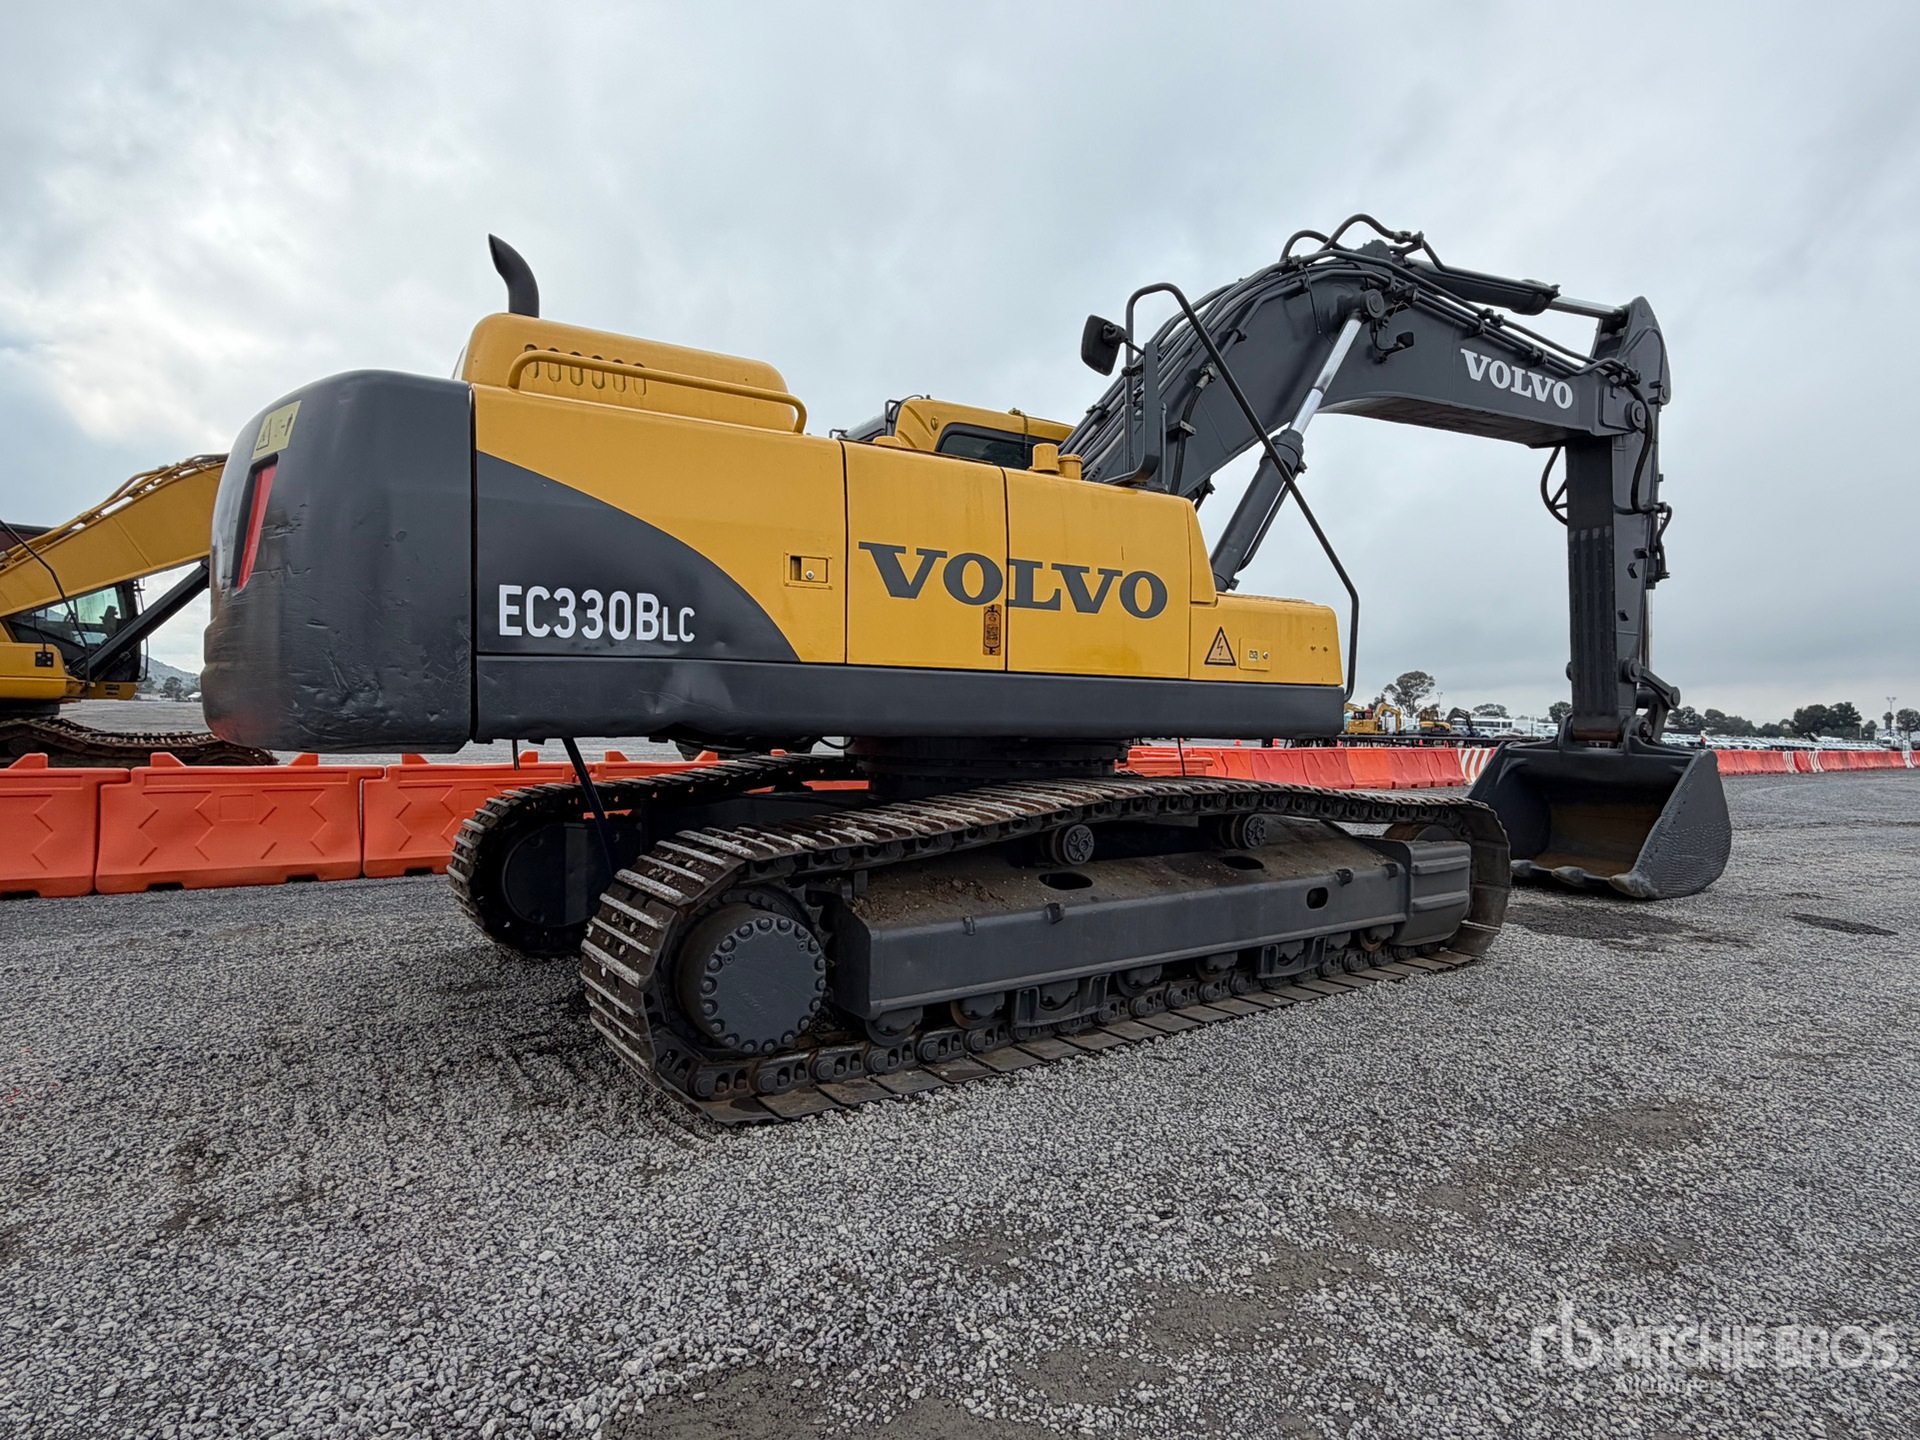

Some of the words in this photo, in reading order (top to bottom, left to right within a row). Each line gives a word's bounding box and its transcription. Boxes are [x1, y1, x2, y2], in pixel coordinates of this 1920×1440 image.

[1460, 348, 1573, 410] VOLVO
[858, 541, 1168, 619] VOLVO
[499, 584, 695, 642] EC330BLC
